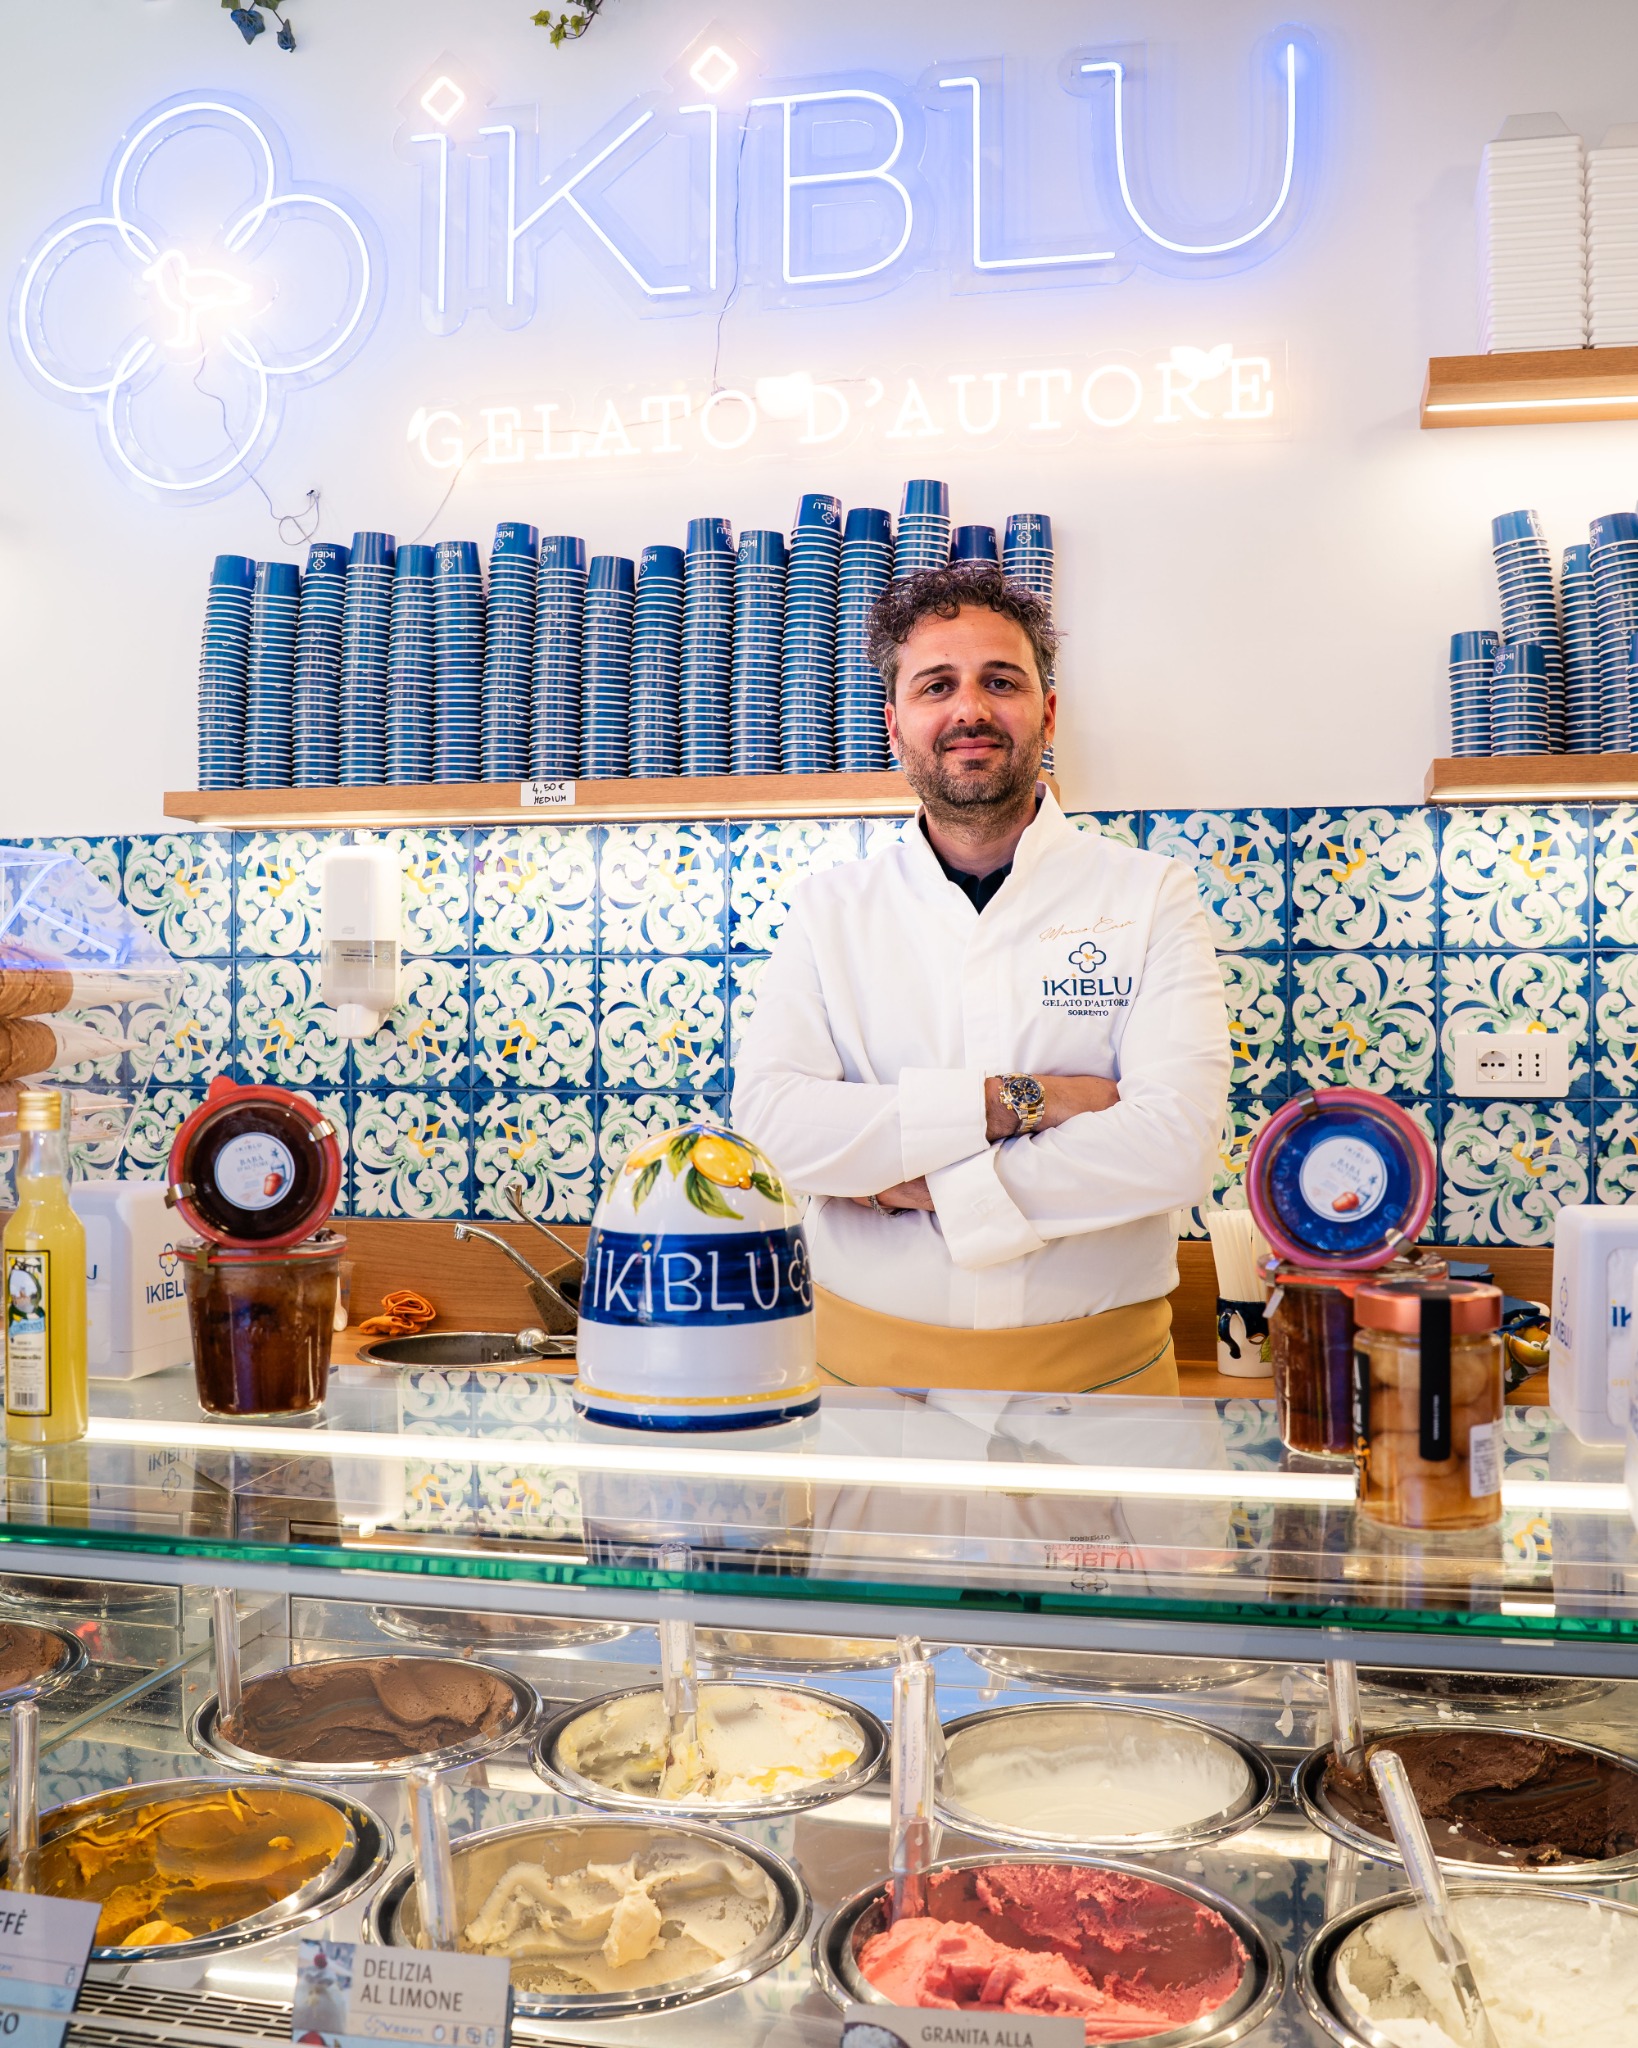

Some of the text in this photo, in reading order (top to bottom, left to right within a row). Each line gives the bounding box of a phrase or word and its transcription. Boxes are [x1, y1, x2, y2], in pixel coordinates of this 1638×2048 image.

[418, 356, 1274, 469] GELATO D'AUTORE
[532, 782, 556, 794] 4,50
[533, 795, 567, 805] MEDIUM
[1042, 998, 1131, 1008] GELATO D'AUTORE
[1067, 1009, 1109, 1017] SORRENTO
[363, 1958, 433, 1984] DELIZIA
[360, 1984, 464, 2012] AL LIMONE
[921, 2025, 1034, 2048] GRANITA ALLA
